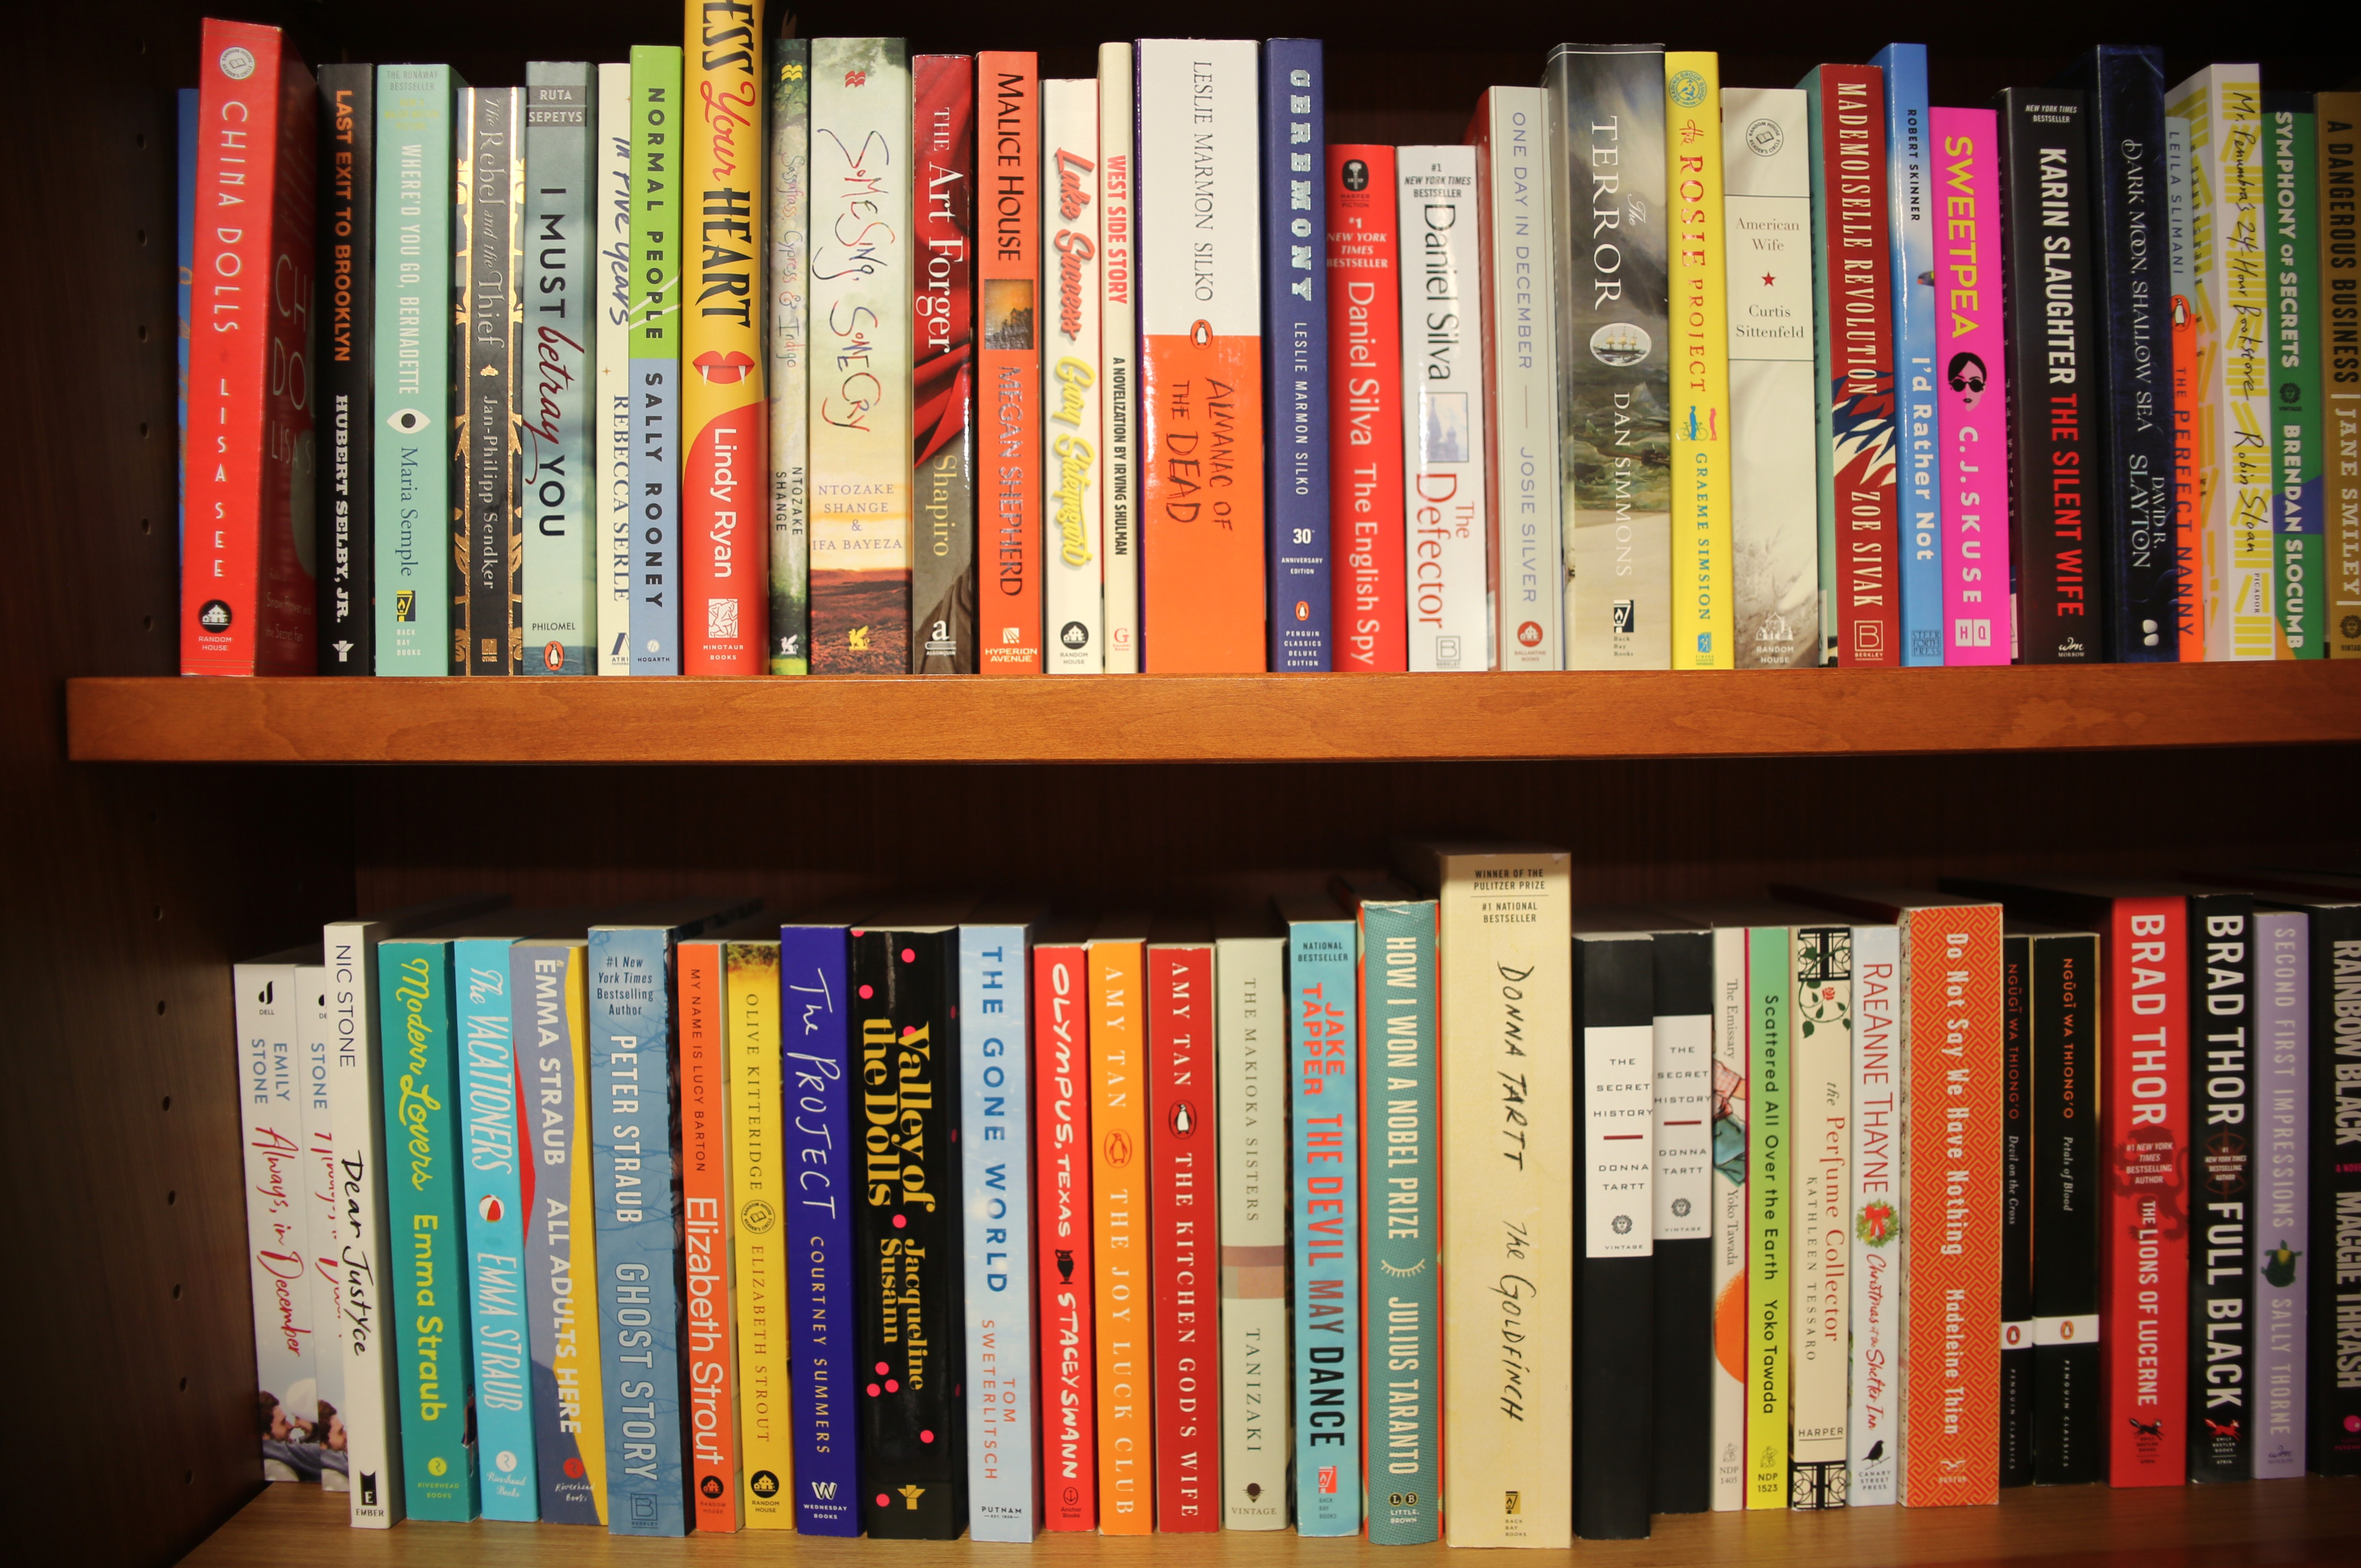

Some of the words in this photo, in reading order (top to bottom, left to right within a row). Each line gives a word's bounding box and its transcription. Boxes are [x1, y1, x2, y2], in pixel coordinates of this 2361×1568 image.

[403, 71, 438, 79] RUNAWAY
[540, 89, 572, 100] RUTA
[335, 90, 353, 143] LAST
[529, 112, 582, 123] SEPETYS
[934, 107, 950, 151] THE
[998, 74, 1024, 166] MALICE
[1907, 109, 1918, 158] ROBERT
[217, 101, 248, 206] CHINA
[335, 152, 352, 200] EXIT
[647, 88, 665, 212] NORMAL
[1431, 164, 1441, 172] #1
[2169, 132, 2181, 185] LEILA
[2275, 112, 2296, 238] SYMPHONY
[401, 145, 421, 216] WHERE'D
[928, 162, 963, 223] Art
[1405, 177, 1421, 185] NEW
[1424, 177, 1444, 185] YORK
[1447, 176, 1471, 185] TIMES
[1414, 189, 1461, 197] BESTSELLER
[1909, 165, 1920, 221] SKINNER
[2039, 148, 2069, 227] KARIN
[334, 207, 351, 237] TO
[400, 224, 421, 255] YOU
[998, 176, 1024, 260] HOUSE
[1736, 218, 1800, 231] American
[1752, 238, 1784, 251] Wife
[2172, 195, 2184, 274] SLIMANI
[213, 228, 242, 332] DOLLS
[397, 263, 420, 288] GO,
[2281, 245, 2294, 266] OF
[334, 244, 353, 361] BROOKLYN
[646, 231, 664, 339] PEOPLE
[916, 237, 963, 353] Forger
[1749, 305, 1790, 318] Curtis
[2044, 237, 2076, 384] SLAUGHTER
[399, 298, 420, 394] BERNADETTE
[1294, 323, 1307, 372] LESLIE
[1736, 325, 1804, 338] Sittenfeld
[2281, 272, 2300, 368] SECRETS
[645, 373, 663, 462] SALLY
[1113, 366, 1126, 443] NOVELIZATION
[1295, 381, 1308, 444] MARMON
[2051, 394, 2078, 441] THE
[335, 396, 348, 495] HUBERT
[1113, 447, 1126, 460] BY
[400, 447, 418, 502] Maria
[1113, 464, 1126, 501] IRVING
[1295, 453, 1308, 495] SILKO
[2053, 452, 2082, 540] SILENT
[2283, 425, 2302, 533] BRENDAN
[334, 501, 348, 582] SELBY,
[396, 509, 418, 576] Semple
[645, 483, 663, 608] ROONEY
[1115, 504, 1127, 555] SHULMAN
[336, 587, 348, 623] JR.
[2056, 550, 2084, 617] WIFE
[2285, 539, 2304, 649] SLOCUMB
[1474, 882, 1515, 890] PULITZER
[1496, 902, 1537, 910] NATIONAL
[1483, 914, 1536, 923] BESTSELLER
[336, 945, 353, 983] NIC
[598, 973, 619, 983] York
[623, 973, 652, 983] Times
[606, 957, 618, 967] #1
[623, 957, 643, 967] New
[691, 969, 701, 989] MY
[982, 947, 1003, 1014] THE
[2275, 928, 2295, 1007] SECOND
[597, 988, 653, 1001] Bestselling
[609, 1004, 642, 1015] Author
[692, 997, 702, 1038] NAME
[1244, 978, 1256, 1018] THE
[337, 992, 356, 1067] STONE
[692, 1046, 702, 1058] IS
[746, 993, 759, 1055] OLIVE
[1765, 996, 1779, 1092] Scattered
[2275, 1020, 2295, 1076] FIRST
[252, 1039, 268, 1104] STONE
[274, 1043, 290, 1100] EMILY
[693, 1067, 703, 1104] LUCY
[983, 1038, 1005, 1140] GONE
[1245, 1029, 1258, 1127] MAKIOKA
[694, 1111, 705, 1172] BARTON
[747, 1066, 762, 1190] KITTERIDGE
[1765, 1102, 1779, 1126] All
[1246, 1138, 1259, 1221] SISTERS
[1765, 1135, 1779, 1181] Over
[2272, 1090, 2295, 1228] IMPRESSIONS
[985, 1164, 1007, 1291] WORLD
[1111, 1189, 1129, 1249] THE
[1765, 1189, 1779, 1220] the
[2141, 1201, 2156, 1224] THE
[1764, 1229, 1778, 1280] Earth
[2138, 1230, 2158, 1284] LIONS
[616, 1263, 653, 1369] GHOST
[1112, 1266, 1130, 1322] JOY
[1764, 1299, 1778, 1340] Yoko
[2139, 1291, 2158, 1314] OF
[1113, 1342, 1132, 1419] LUCK
[1246, 1329, 1261, 1452] TANIZAKI
[1763, 1345, 1777, 1414] Tawada
[2138, 1320, 2158, 1406] LUCERNE
[620, 1381, 658, 1481] STORY
[1799, 1427, 1844, 1436] HARPER
[1115, 1438, 1133, 1513] CLUB
[1758, 1473, 1778, 1481] NDP
